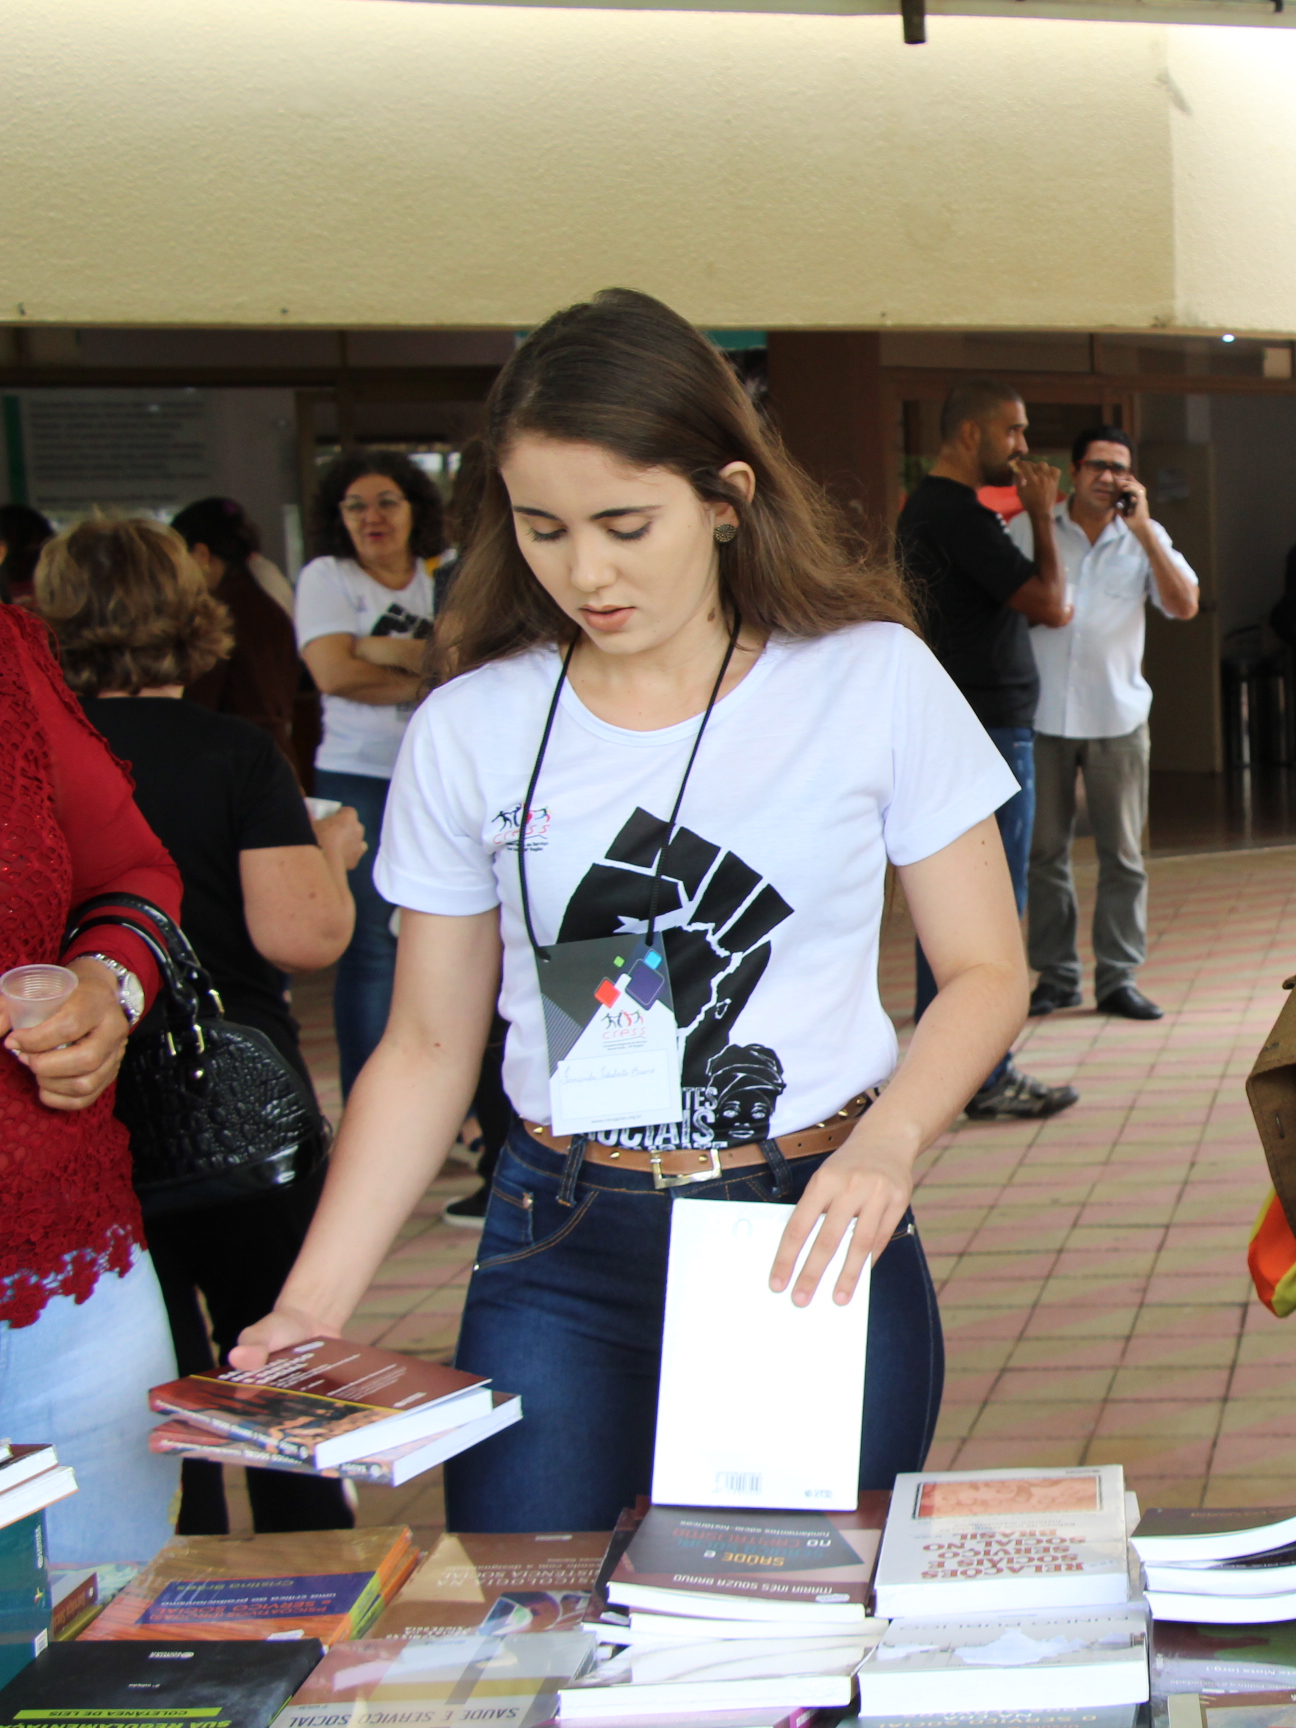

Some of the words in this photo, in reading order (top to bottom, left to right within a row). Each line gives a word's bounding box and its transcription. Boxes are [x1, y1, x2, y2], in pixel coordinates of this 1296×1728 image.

[682, 1086, 718, 1111] TES
[587, 1109, 717, 1148] OCIAIS
[671, 1528, 802, 1548] CAPITALISMO
[951, 1528, 1058, 1541] BRASIL
[922, 1541, 965, 1553] NO
[977, 1535, 1086, 1548] SOCIAL
[937, 1544, 1071, 1560] SERVIÇO
[720, 1551, 785, 1568] SAÚDE
[927, 1560, 945, 1570] E
[957, 1553, 1079, 1569] SOCIAIS
[921, 1562, 1084, 1580] RELAÇÕES
[671, 1573, 715, 1588] BRAVO
[717, 1578, 759, 1592] SOUZA
[761, 1582, 789, 1595] INÊS
[791, 1584, 833, 1596] MARIA
[309, 1591, 337, 1600] uma
[155, 1603, 245, 1615] SOCIAL
[226, 1605, 328, 1619] PSICOATIVOS
[250, 1599, 315, 1612] SERVIÇO
[1243, 1667, 1276, 1677] Mota
[84, 1710, 102, 1718] DE
[104, 1709, 188, 1719] COLETÂNEA
[289, 1713, 353, 1728] SOCIAL
[358, 1709, 436, 1725] SERVIÇO
[443, 1709, 455, 1721] E
[461, 1706, 520, 1722] SAÚDE
